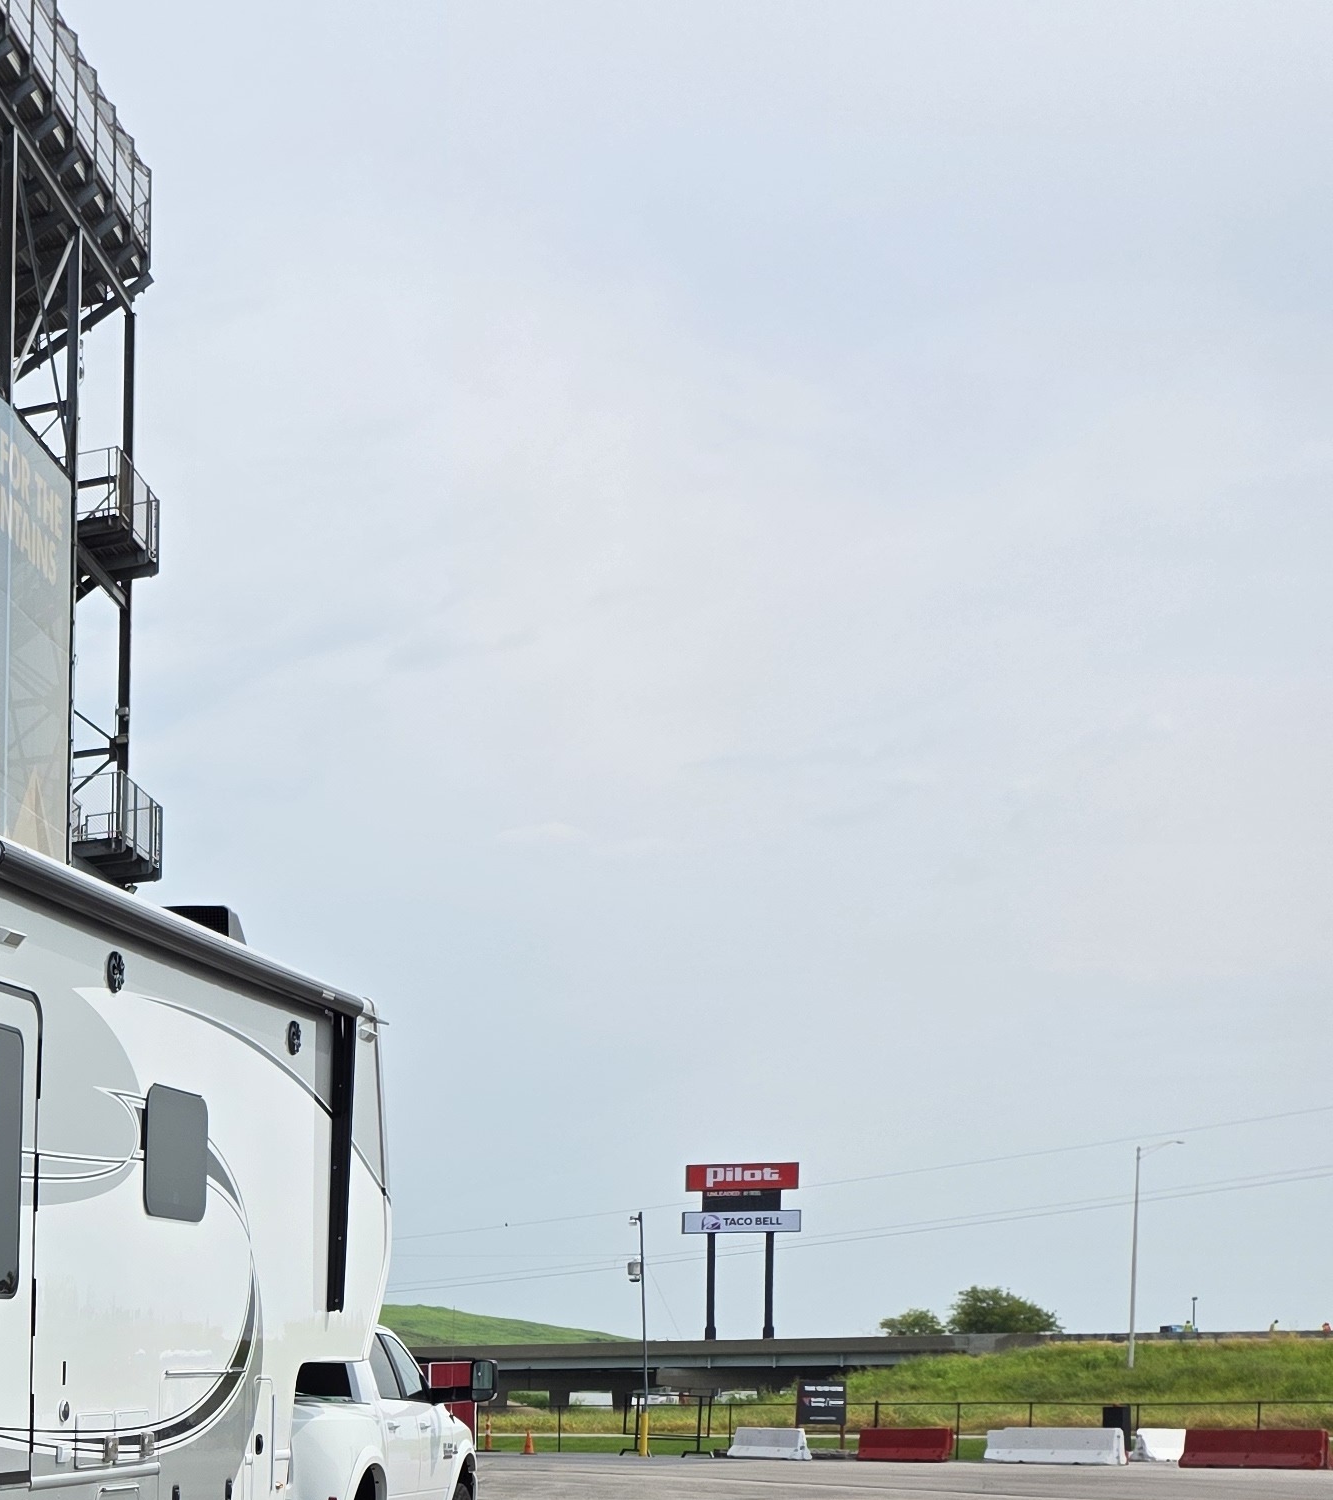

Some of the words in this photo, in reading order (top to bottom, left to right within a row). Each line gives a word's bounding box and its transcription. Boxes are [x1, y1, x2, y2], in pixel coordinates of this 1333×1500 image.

[0, 427, 31, 501] FOR
[34, 470, 63, 542] THE
[723, 1217, 753, 1227] TACO
[755, 1216, 783, 1226] BELL
